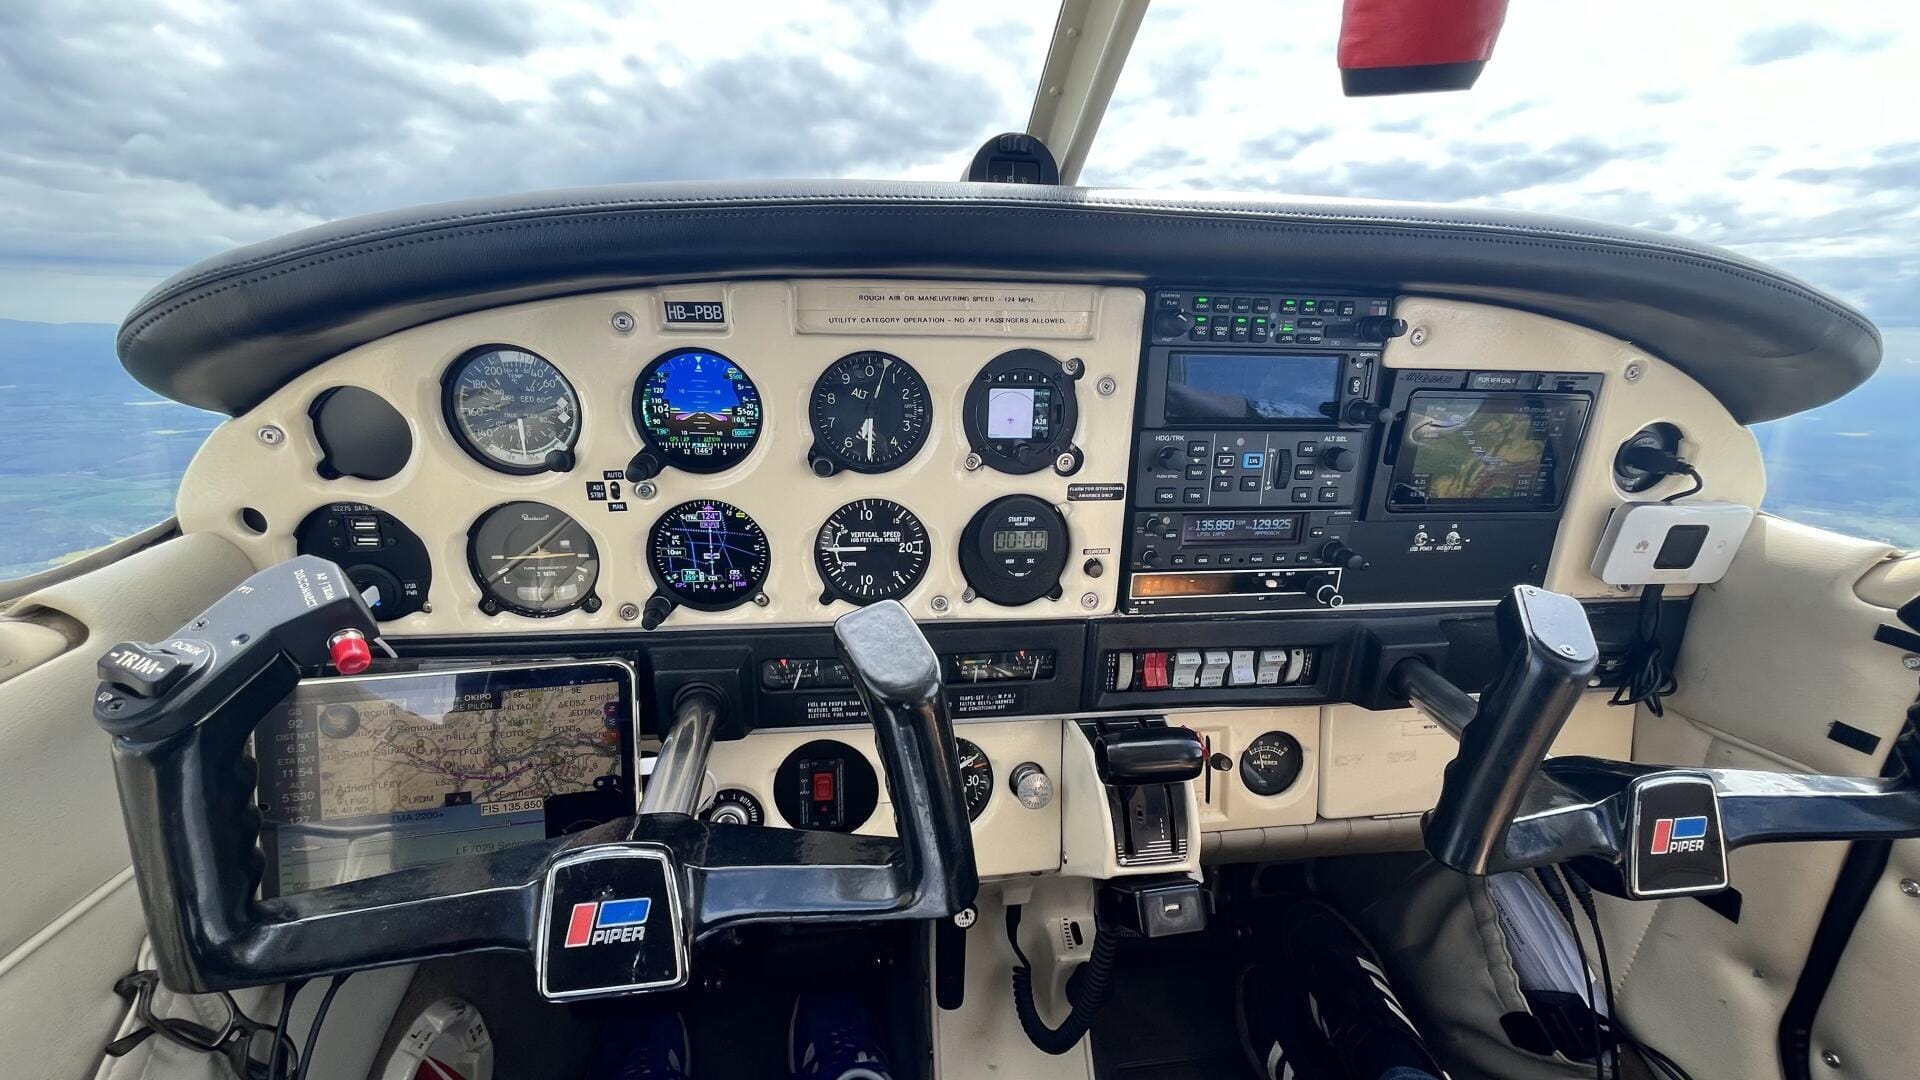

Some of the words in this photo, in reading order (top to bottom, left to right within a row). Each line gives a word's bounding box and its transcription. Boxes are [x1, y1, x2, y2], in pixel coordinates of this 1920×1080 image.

[667, 304, 723, 320] HB-PBB
[484, 367, 503, 376] 200
[531, 369, 543, 378] 40
[865, 366, 875, 376] 0
[472, 380, 487, 389] 180
[542, 380, 555, 388] 60
[842, 374, 850, 385] 9
[827, 393, 835, 404] 8
[851, 387, 869, 399] ALT
[902, 389, 909, 399] 2
[468, 408, 483, 416] 160
[828, 417, 835, 428] 7
[903, 421, 911, 431] 3
[477, 429, 493, 437] 140
[845, 437, 853, 448] 6
[890, 436, 899, 446] 4
[860, 510, 873, 520] 10
[1196, 520, 1235, 531] 135.850
[1252, 519, 1291, 530] 129.925
[996, 531, 1044, 549] 00:00
[899, 542, 913, 553] 20
[861, 575, 873, 585] 10
[294, 569, 318, 608] DISCONNECT
[171, 641, 205, 656] DOWN
[464, 694, 492, 702] OKIPO
[288, 720, 303, 728] 92
[287, 744, 306, 753] 6.3
[966, 775, 979, 786] 30
[739, 796, 751, 806] BOTH
[482, 805, 499, 814] FIS
[503, 800, 542, 811] 135.850
[749, 805, 757, 822] START
[1669, 840, 1704, 854] PIPER
[592, 926, 645, 946] PIPER
